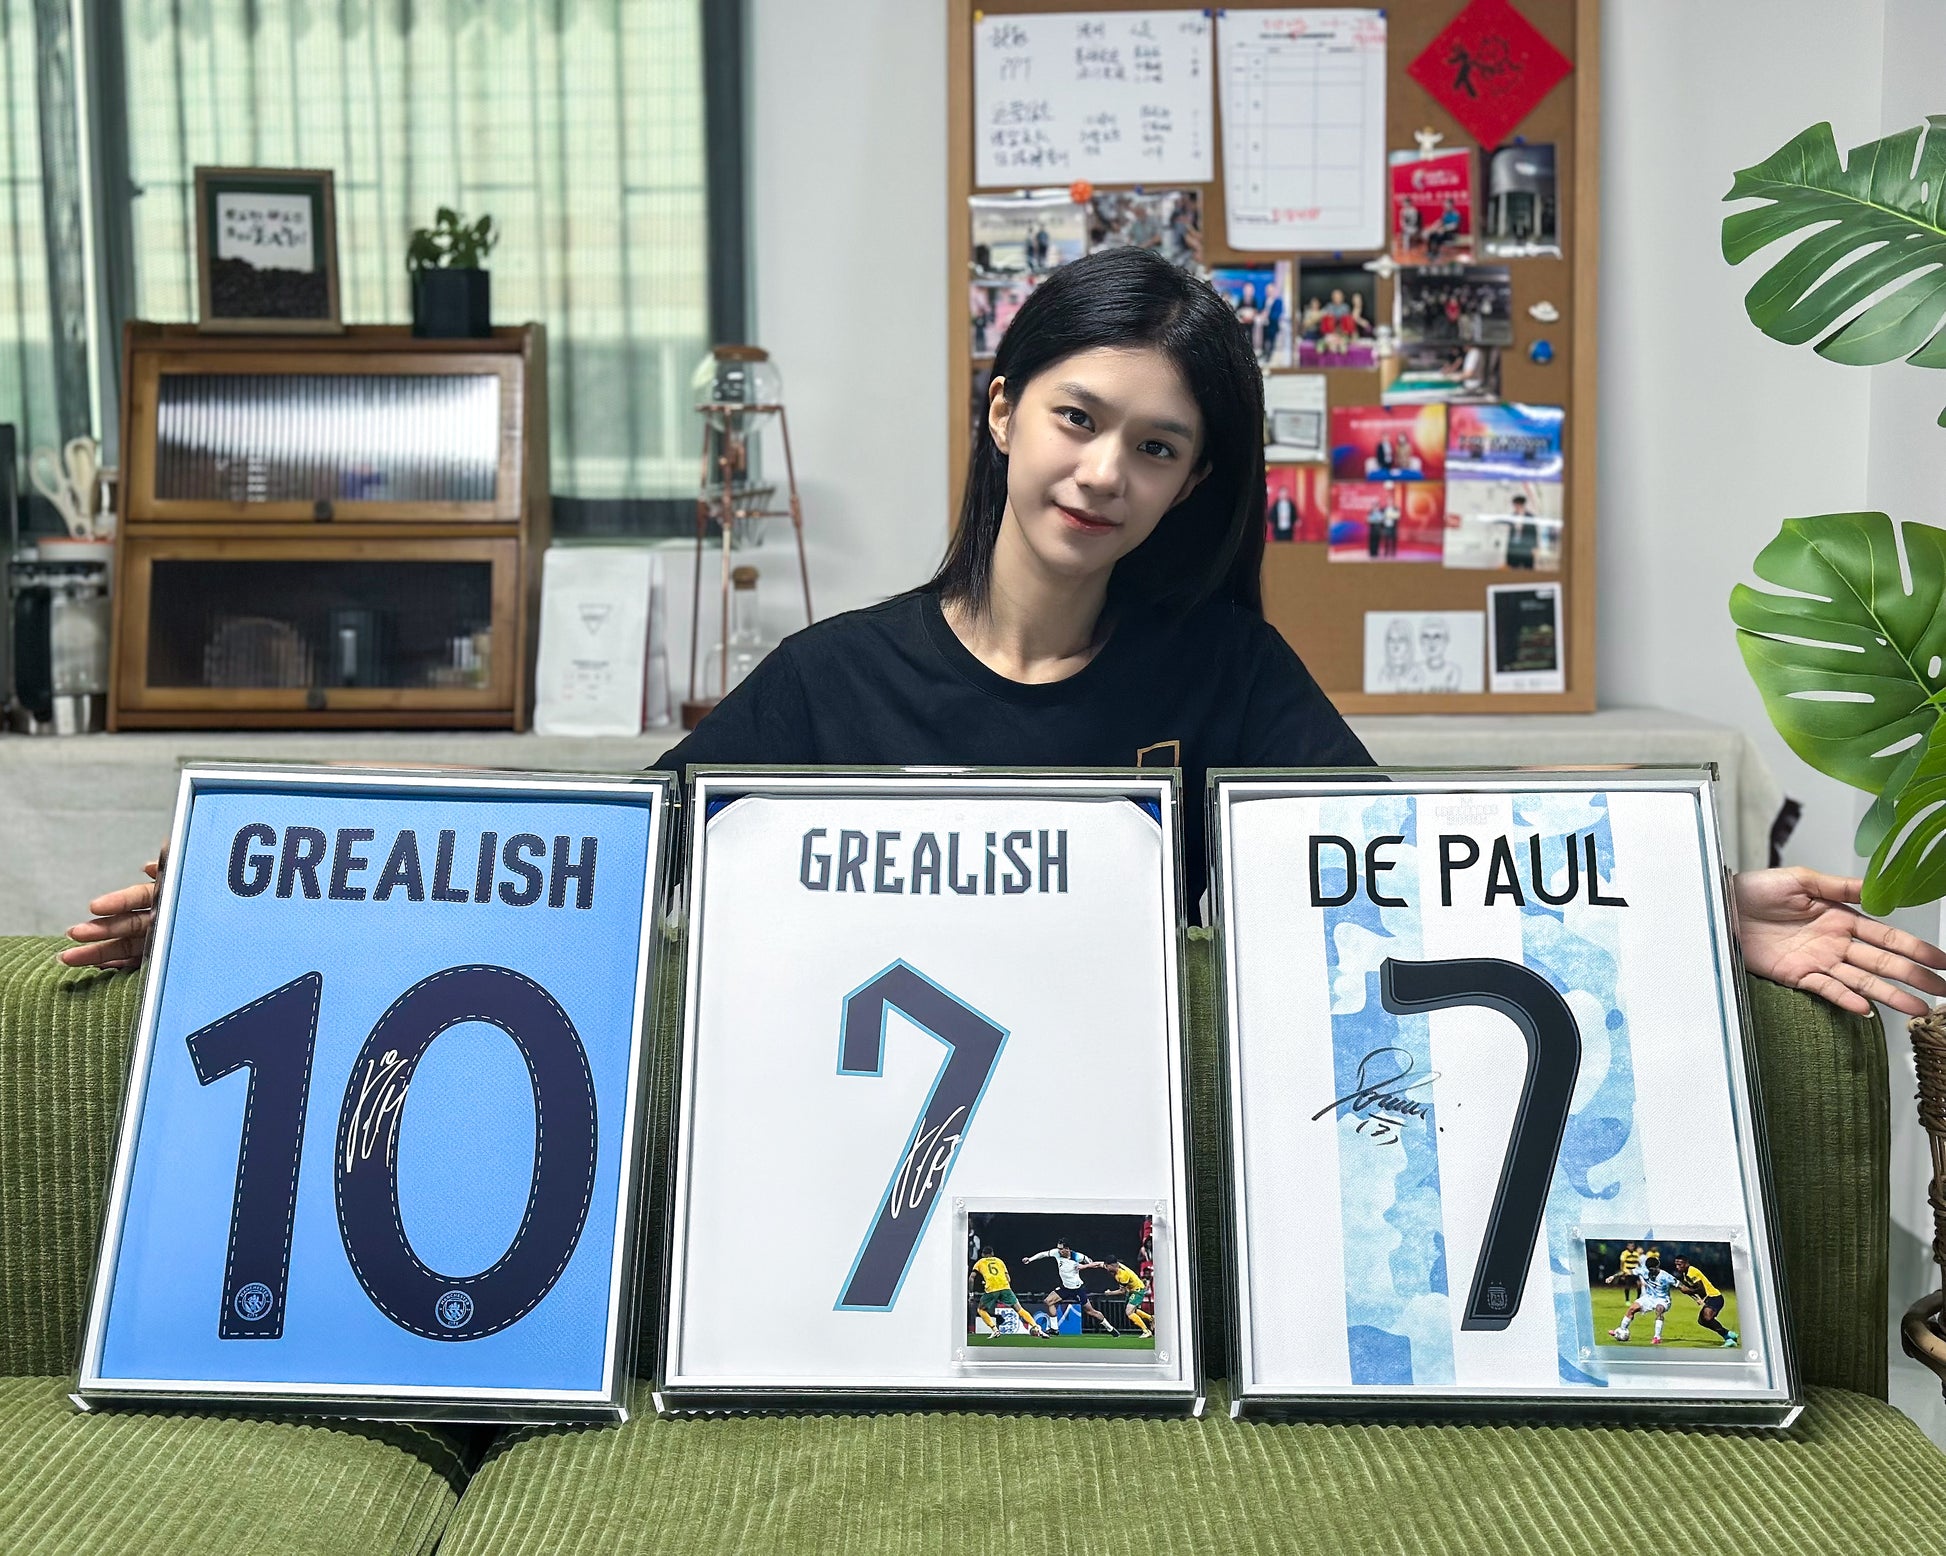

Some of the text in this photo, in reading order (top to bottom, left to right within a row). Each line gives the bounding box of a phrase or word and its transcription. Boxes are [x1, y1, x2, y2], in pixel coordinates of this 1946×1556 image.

[226, 821, 599, 911] GREALISH
[1309, 832, 1630, 908] DE PAUL
[185, 963, 599, 1343] 10
[832, 957, 1012, 1313] 7
[1378, 956, 1583, 1332] 7
[240, 1285, 270, 1297] MANCHESTER
[440, 1293, 470, 1306] MANCHESTER
[987, 1262, 999, 1276] 6
